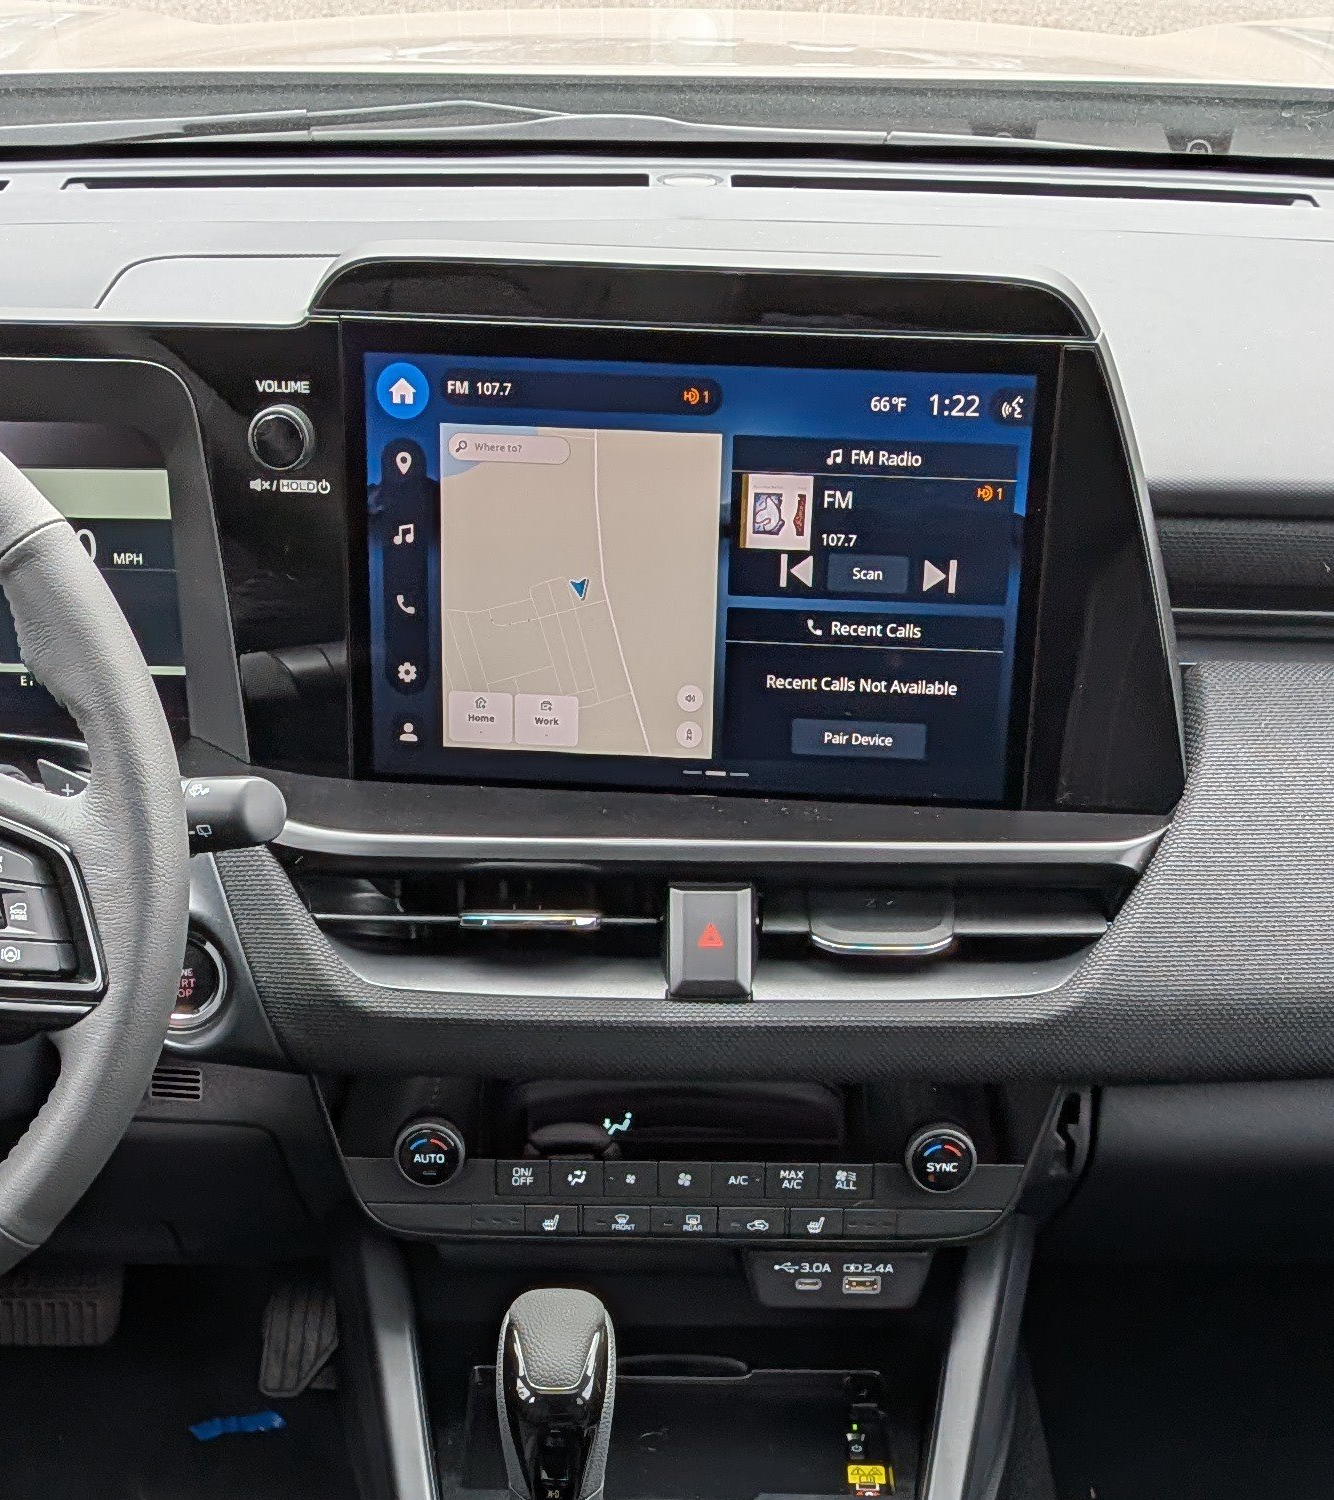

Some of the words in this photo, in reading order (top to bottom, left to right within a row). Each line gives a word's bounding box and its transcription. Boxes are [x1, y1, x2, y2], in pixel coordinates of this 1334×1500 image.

[255, 380, 311, 393] VOLUME
[447, 380, 469, 395] FM
[476, 381, 512, 397] 107.7
[703, 391, 710, 404] 1
[870, 396, 907, 412] 66°F
[929, 394, 980, 417] 1:22
[474, 441, 506, 453] Where
[507, 443, 523, 454] to?
[851, 450, 874, 465] FM
[878, 451, 922, 467] Radio
[281, 481, 316, 491] HOLD
[823, 490, 853, 509] FM
[996, 487, 1003, 500] 1
[821, 533, 857, 548] 107.7
[113, 553, 143, 565] MPH
[852, 567, 883, 581] Scan
[830, 621, 882, 637] Recent
[886, 623, 922, 639] Calls
[766, 674, 817, 690] Recent
[821, 676, 856, 692] Calls
[859, 678, 887, 693] Not
[890, 679, 958, 696] Available
[468, 713, 495, 724] Home
[534, 715, 559, 726] Work
[823, 731, 849, 745] Pair
[851, 732, 893, 747] Device
[413, 1153, 445, 1164] AUTO
[512, 1167, 533, 1177] ON/
[926, 1162, 959, 1173] SYNC
[728, 1175, 749, 1185] A/C
[780, 1170, 805, 1179] MAX
[511, 1177, 534, 1186] OFF
[782, 1180, 803, 1189] A/C
[835, 1181, 857, 1190] ALL
[800, 1263, 832, 1273] 3.0A
[863, 1263, 894, 1273] 2.4A
